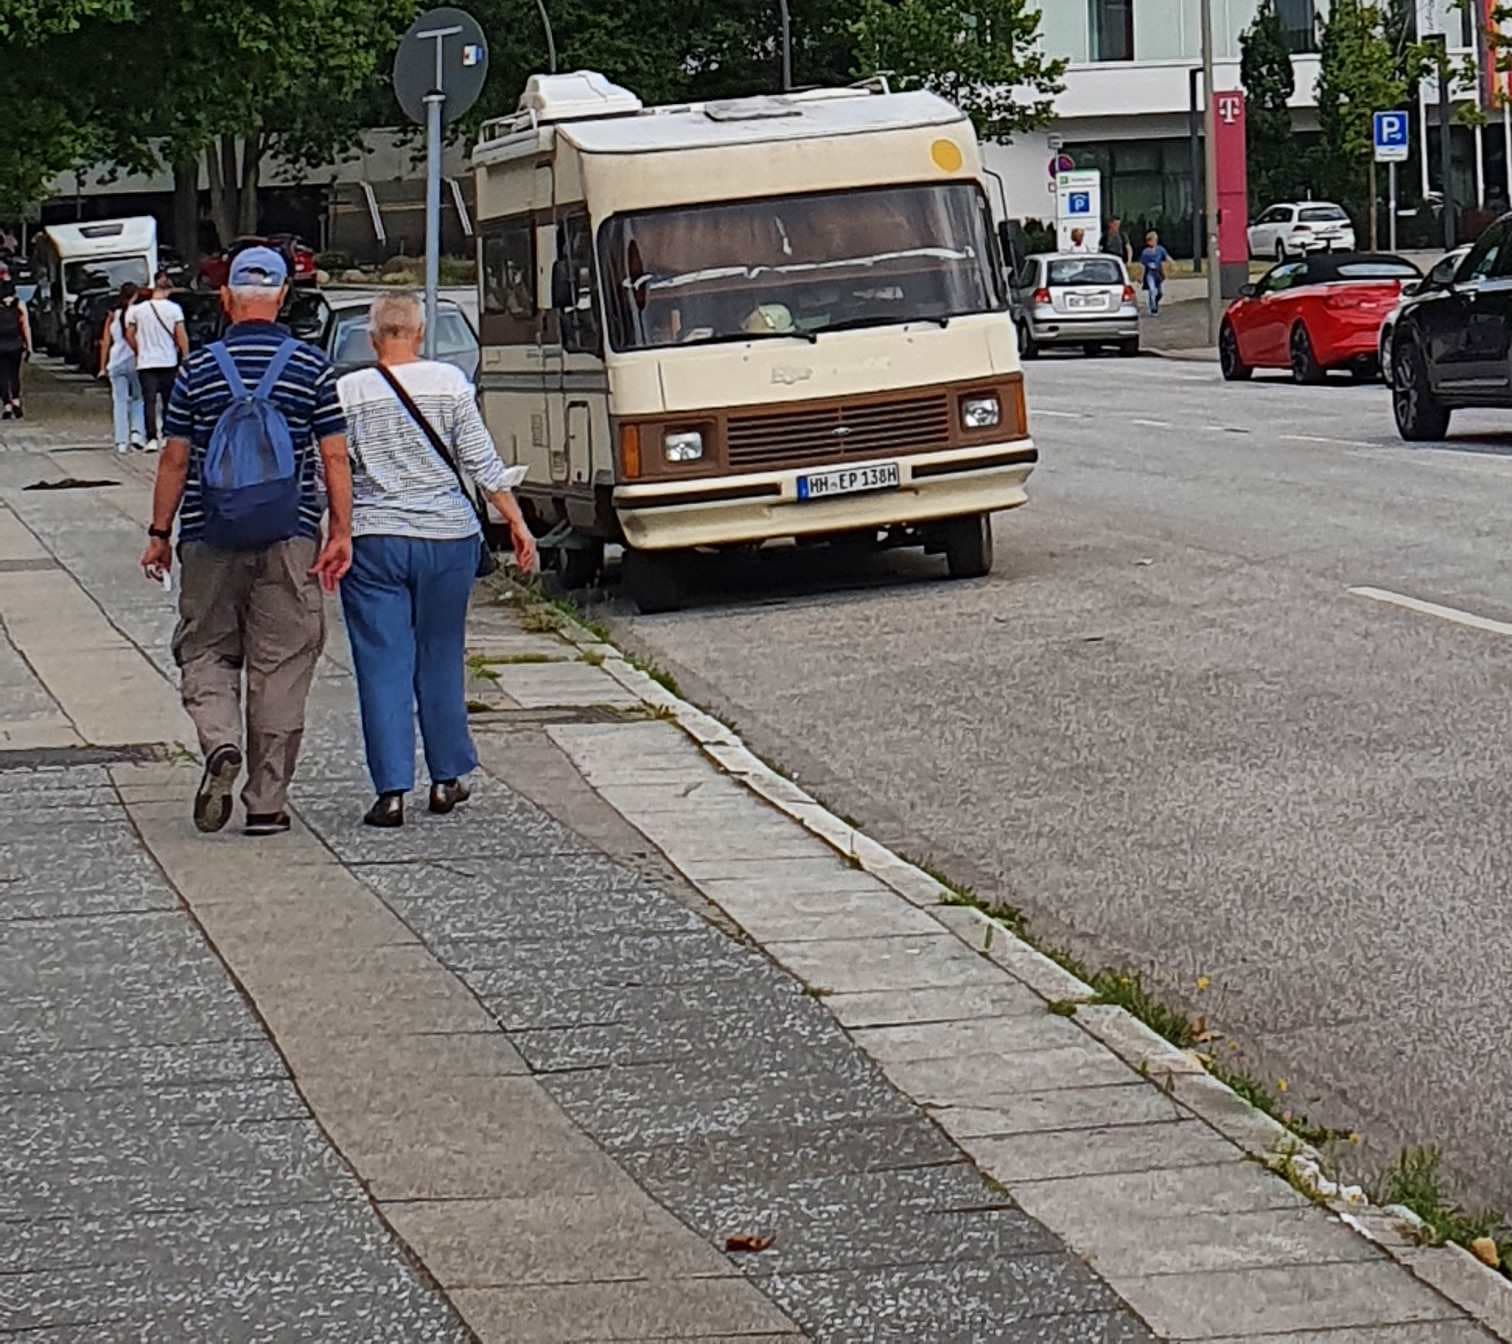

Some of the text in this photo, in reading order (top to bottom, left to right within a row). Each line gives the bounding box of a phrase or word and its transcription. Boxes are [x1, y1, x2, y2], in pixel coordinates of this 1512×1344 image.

[1219, 98, 1239, 123] T
[1382, 116, 1400, 143] P
[810, 467, 897, 493] HH EP 138H
